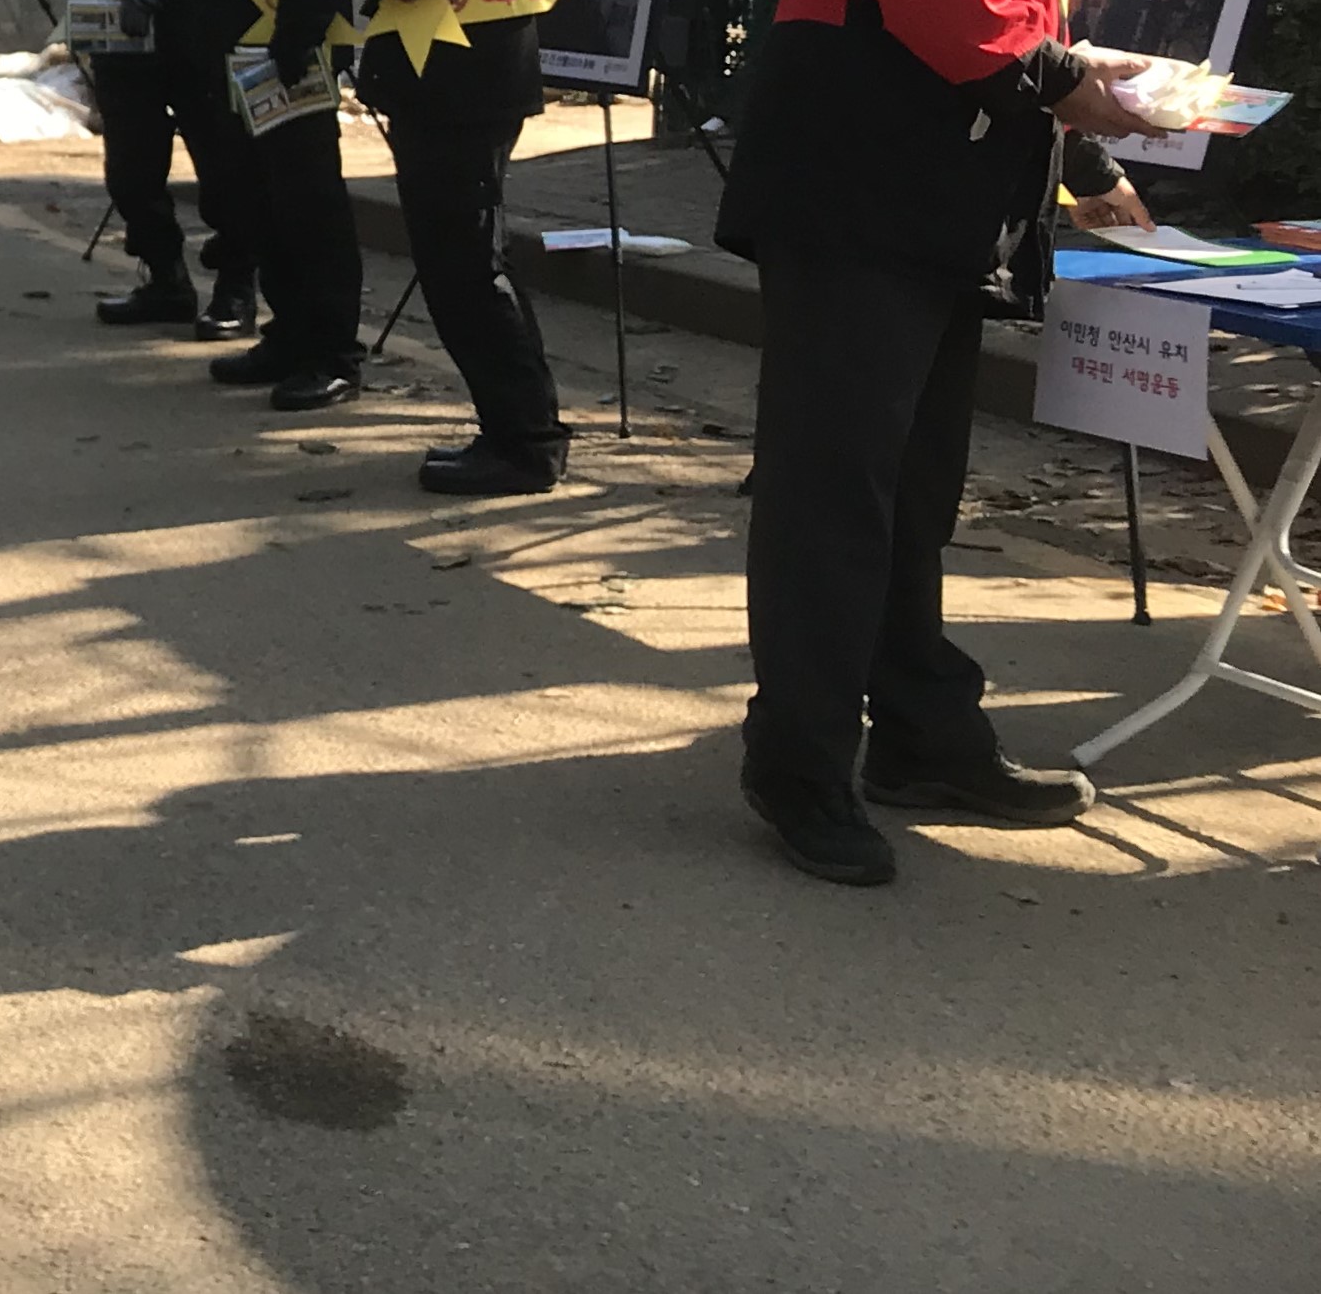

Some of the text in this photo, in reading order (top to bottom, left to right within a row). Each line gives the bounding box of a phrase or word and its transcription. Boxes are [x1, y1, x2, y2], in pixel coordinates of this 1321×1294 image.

[1059, 319, 1189, 363] 이민청 안산시 유치
[1071, 356, 1180, 399] 대국민 서명운동
